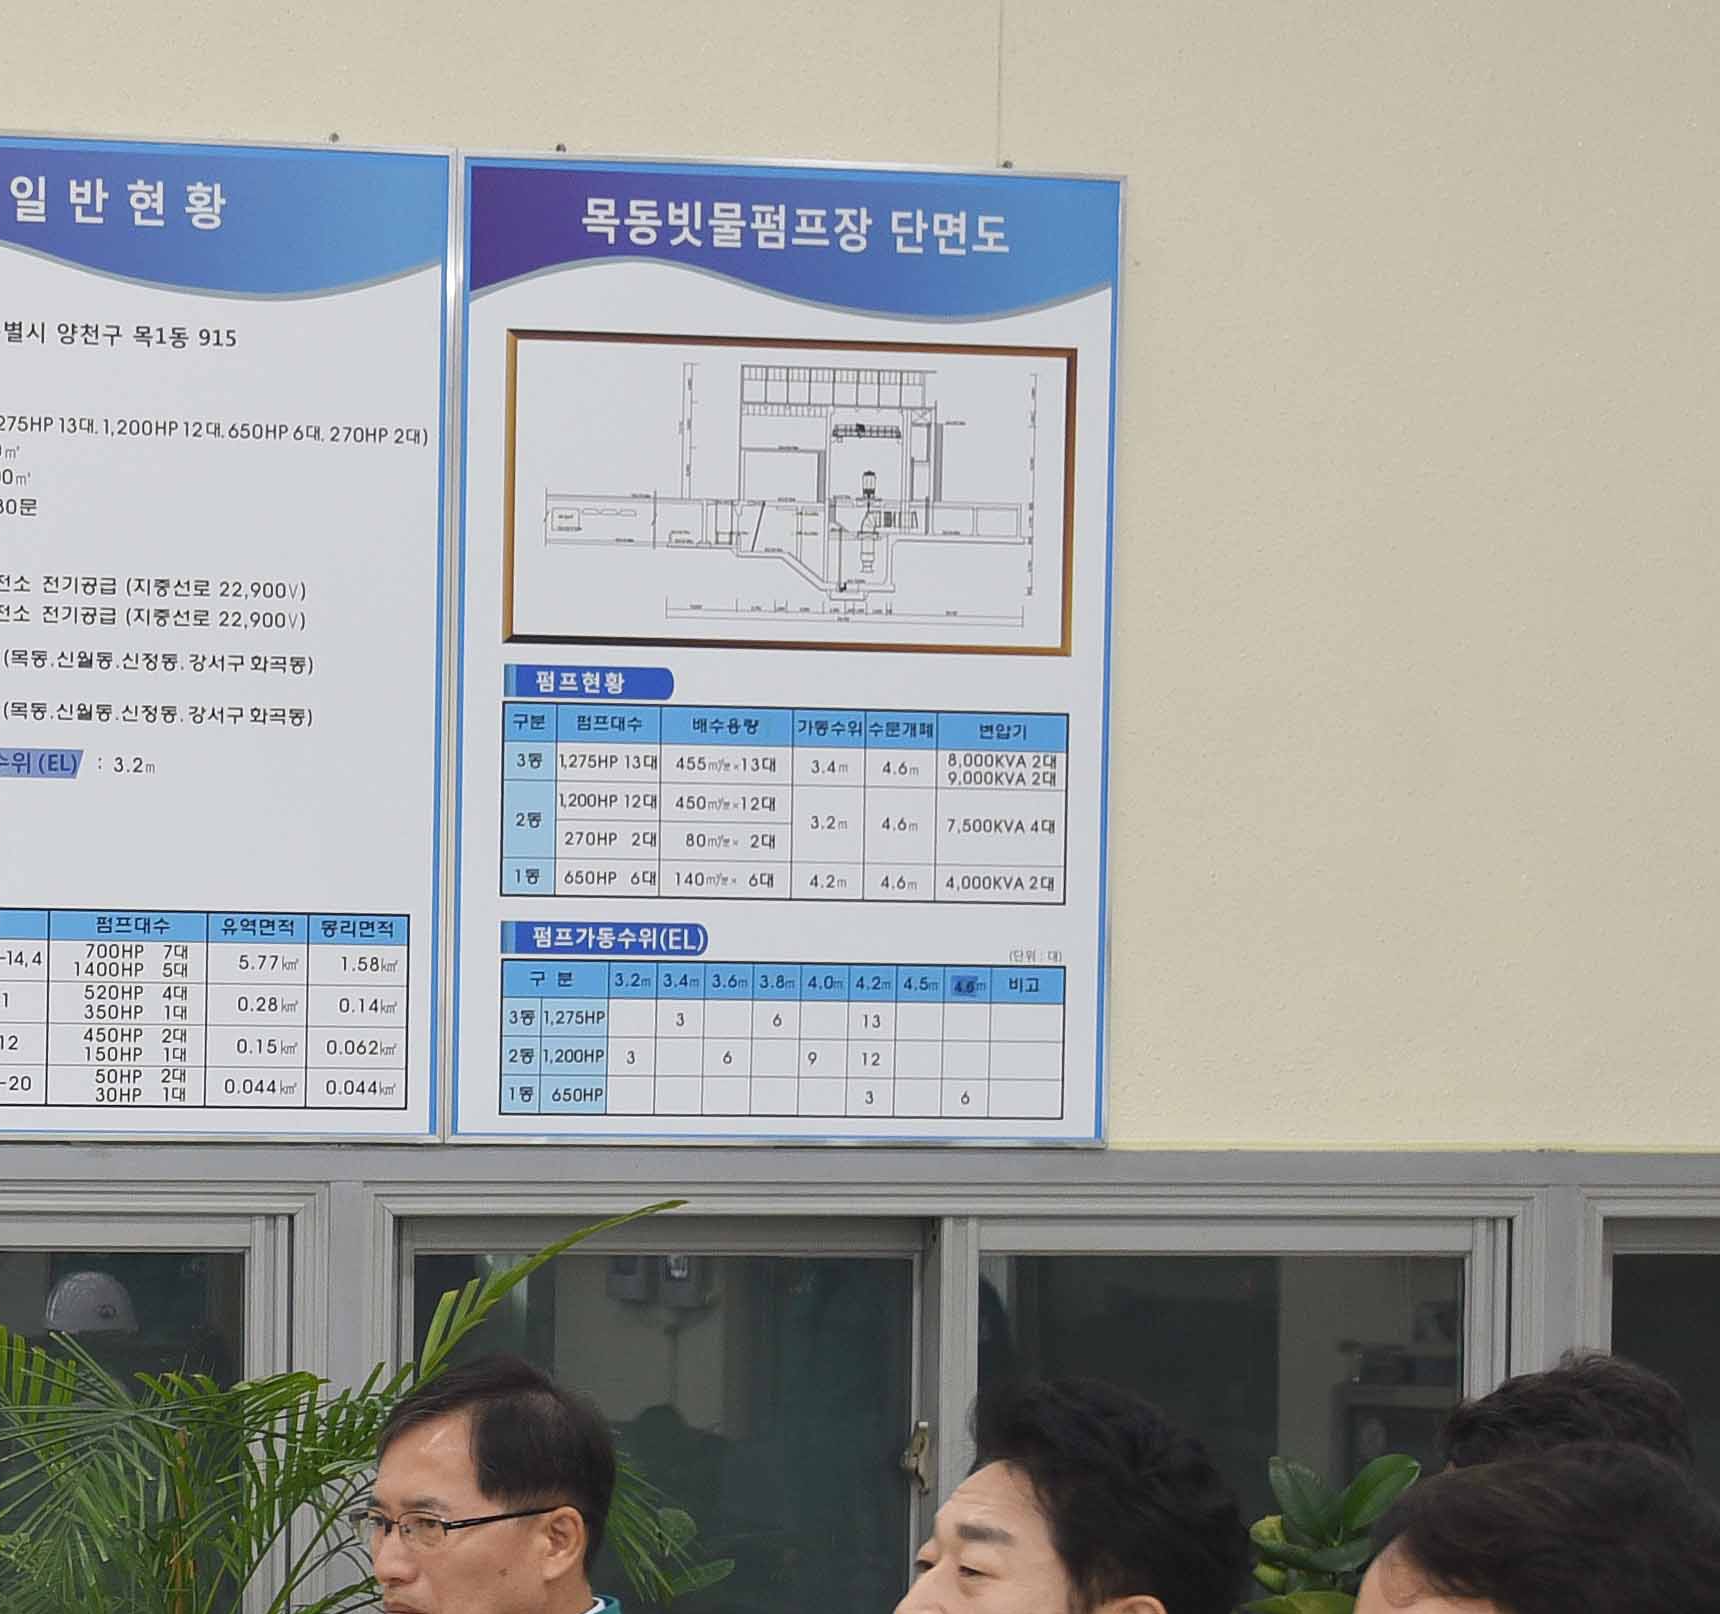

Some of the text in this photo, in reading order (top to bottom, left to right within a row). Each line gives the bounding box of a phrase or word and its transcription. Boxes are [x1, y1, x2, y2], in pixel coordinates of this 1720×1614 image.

[581, 196, 1009, 256] 목동빗물펌프장 단면도
[57, 322, 122, 347] 양천구
[133, 325, 188, 348] 목1동
[199, 327, 237, 347] 915
[330, 427, 388, 444] 270HP
[394, 428, 428, 447] 2대)
[43, 576, 116, 596] 전기공급
[42, 606, 116, 625] 전기공급
[189, 654, 244, 671] 강서구
[250, 656, 313, 674] 화곡동)
[535, 671, 624, 695] 펌프현황
[188, 706, 243, 724] 강서구
[250, 708, 312, 726] 화곡동)
[513, 714, 1027, 740] 구분 펌프대수 배수용량 가동수위 수문개폐 변압기
[38, 754, 78, 776] (EL)
[517, 753, 657, 770] 3동 1,275HP 13대
[948, 754, 1056, 769] 8,000KVA 2대
[1032, 772, 1056, 786] 2대
[516, 794, 657, 828] 2동 1,200HP 12대
[948, 819, 1055, 835] 7,500KVA 4대
[564, 832, 656, 848] 270HP 2대
[515, 869, 656, 887] 1동 650HP 6대
[946, 876, 1054, 892] 4,000KVA 2대
[96, 918, 171, 933] 펌프대수
[222, 918, 294, 936] 유역면적
[321, 920, 394, 939] 몽리면적
[533, 926, 705, 951] 펌프가동수위(EL)
[85, 944, 188, 960] 700HP 7대
[74, 962, 188, 978] 1400HP 5대
[84, 985, 187, 1001] 520HP 4대
[1009, 978, 1039, 993] 비고
[84, 1005, 187, 1020] 350HP 1대
[509, 1010, 881, 1029] 3동 1,275HP 13
[84, 1028, 186, 1043] 450HP 2대
[85, 1048, 186, 1062] 150HP 1대
[509, 1049, 880, 1066] 2동 1,200HP 12
[96, 1069, 142, 1083] 50HP
[509, 1087, 603, 1103] 1동 650HP
